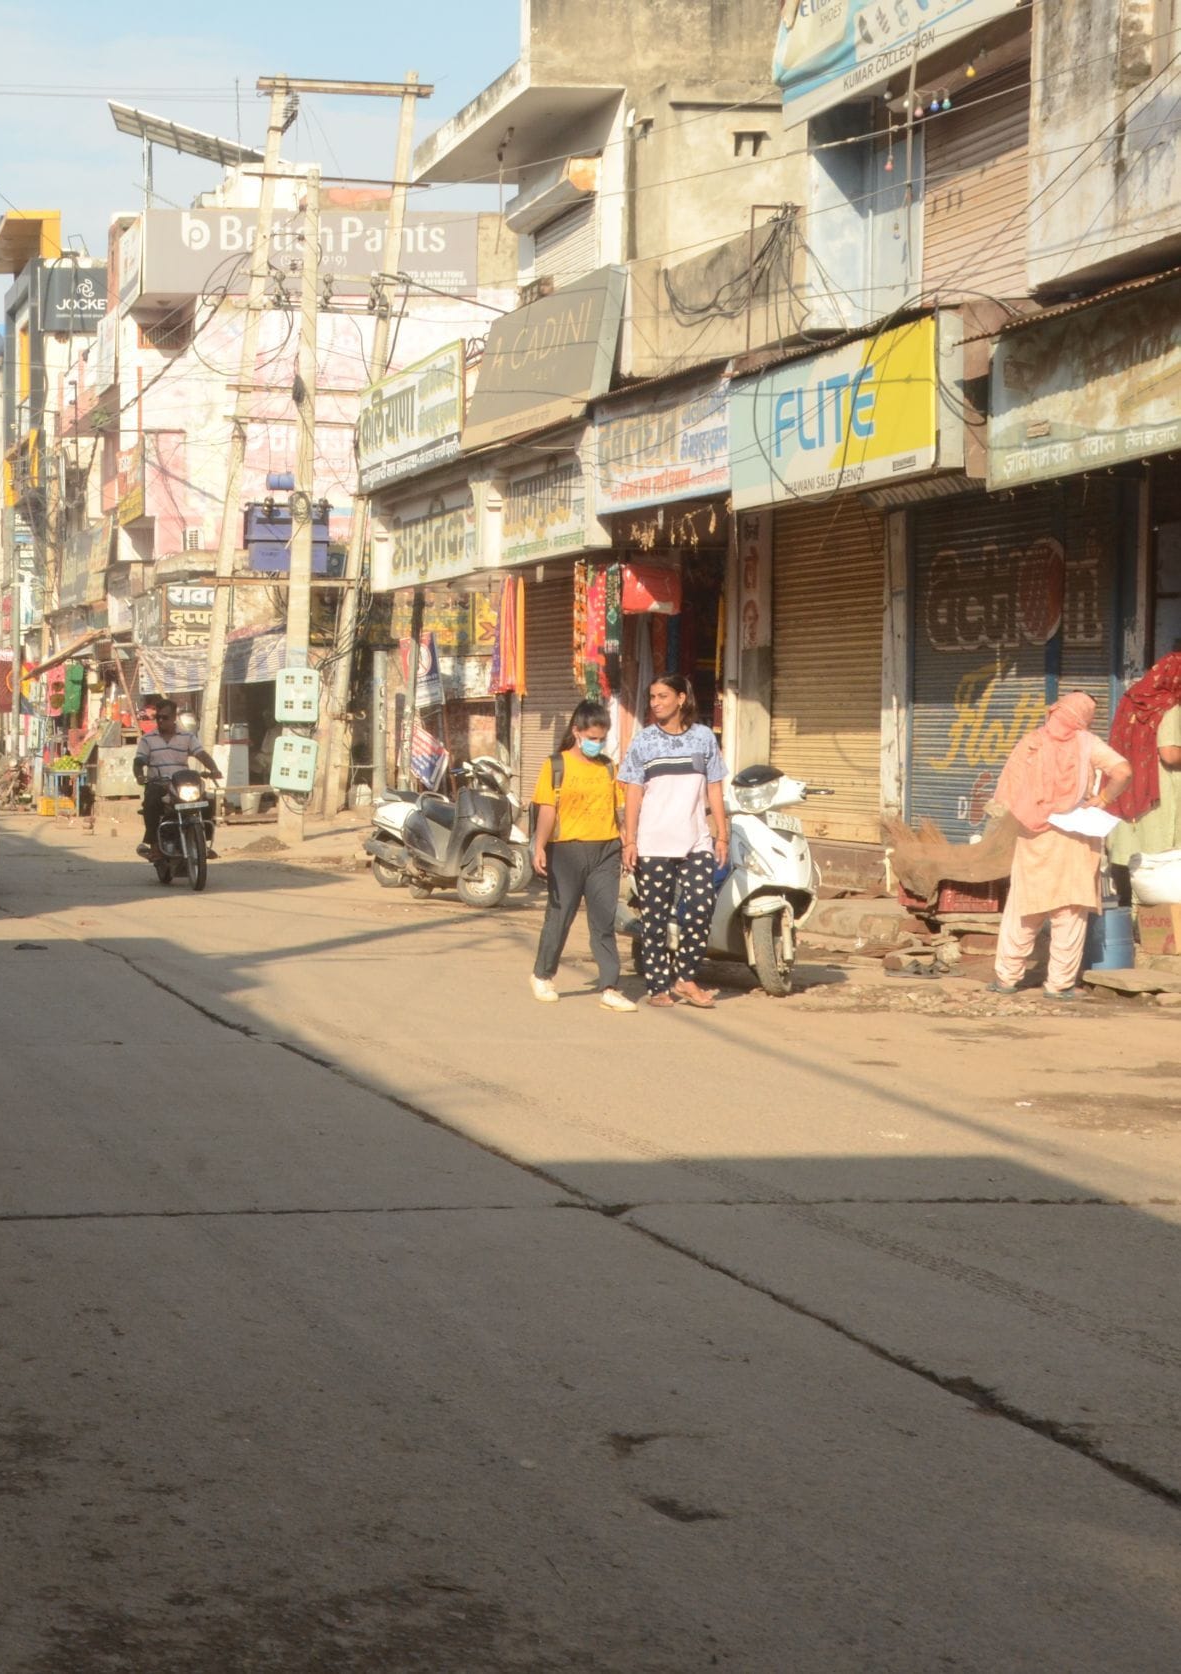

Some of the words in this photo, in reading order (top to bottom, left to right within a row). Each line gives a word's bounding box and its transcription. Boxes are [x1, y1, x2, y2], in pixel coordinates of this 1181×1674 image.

[843, 61, 874, 91] KUMAR
[875, 28, 936, 74] COLLECTON
[220, 215, 334, 252] Brtish
[56, 299, 108, 310] JOCKE
[511, 297, 595, 371] CADINI
[775, 366, 874, 458] FLITE
[816, 473, 836, 491] SALES
